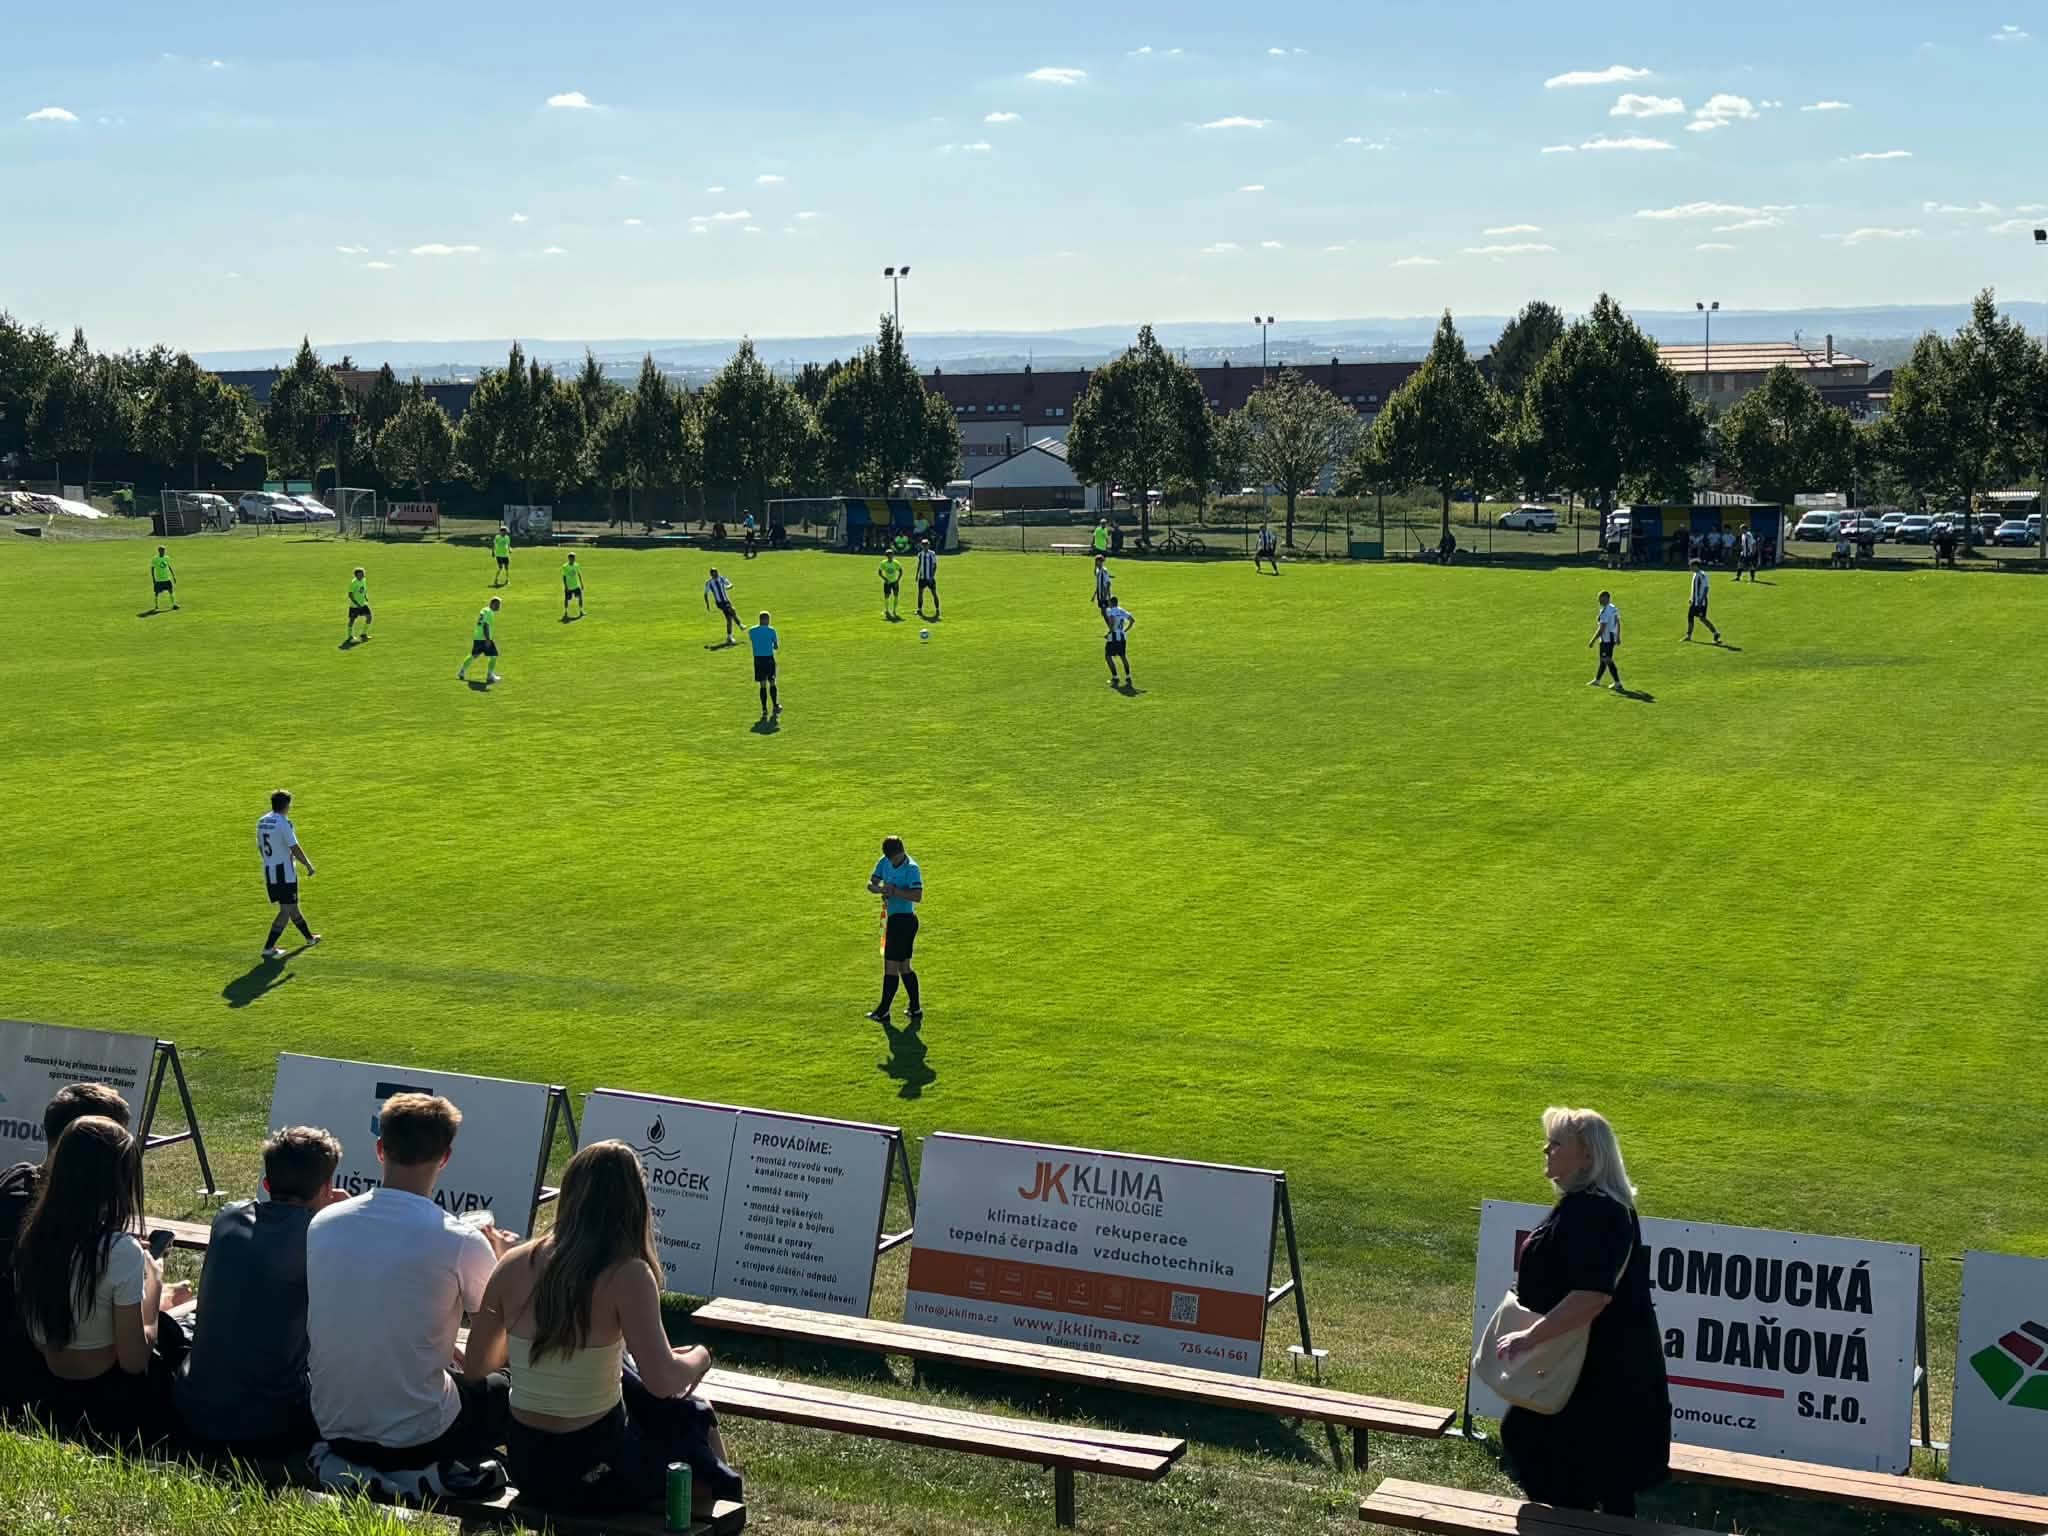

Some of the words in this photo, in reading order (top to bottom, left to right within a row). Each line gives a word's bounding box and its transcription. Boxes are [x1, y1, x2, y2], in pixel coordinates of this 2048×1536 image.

[262, 833, 273, 857] 5
[0, 1119, 43, 1142] mou
[752, 1132, 833, 1156] PROVÁDÍME:
[756, 1154, 786, 1168] montáž
[652, 1168, 711, 1193] ROČEK
[754, 1166, 799, 1181] kanalizace
[1018, 1161, 1072, 1205] JK
[1072, 1164, 1164, 1203] KLIMA
[432, 1188, 494, 1213] AVBY
[751, 1183, 783, 1197] montáž
[749, 1200, 780, 1214] montáž
[782, 1206, 824, 1221] veškerých
[1072, 1193, 1164, 1218] TECHNOLOGIE
[747, 1213, 773, 1226] zdrojů
[775, 1217, 797, 1229] tepla
[987, 1207, 1078, 1233] klimatizace
[1095, 1222, 1188, 1248] rekuperace
[745, 1230, 776, 1244] montáž
[784, 1237, 813, 1250] opravy
[949, 1226, 1007, 1247] tepelná
[1009, 1233, 1079, 1257] čerpadla
[1093, 1245, 1235, 1278] vzduchotechnika
[743, 1242, 789, 1257] domovních
[791, 1250, 825, 1264] vodáren
[741, 1260, 775, 1274] strojové
[1641, 1246, 1873, 1315] LOMOUCKÁ
[913, 1302, 999, 1324] info@jkklima.cz
[1012, 1313, 1141, 1346] www.jkklima.cz
[1663, 1327, 1685, 1359] a
[1695, 1315, 1870, 1382] DAŇOVÁ
[1669, 1402, 1757, 1430] lomouc.cz
[1797, 1390, 1867, 1425] s.r.o.
